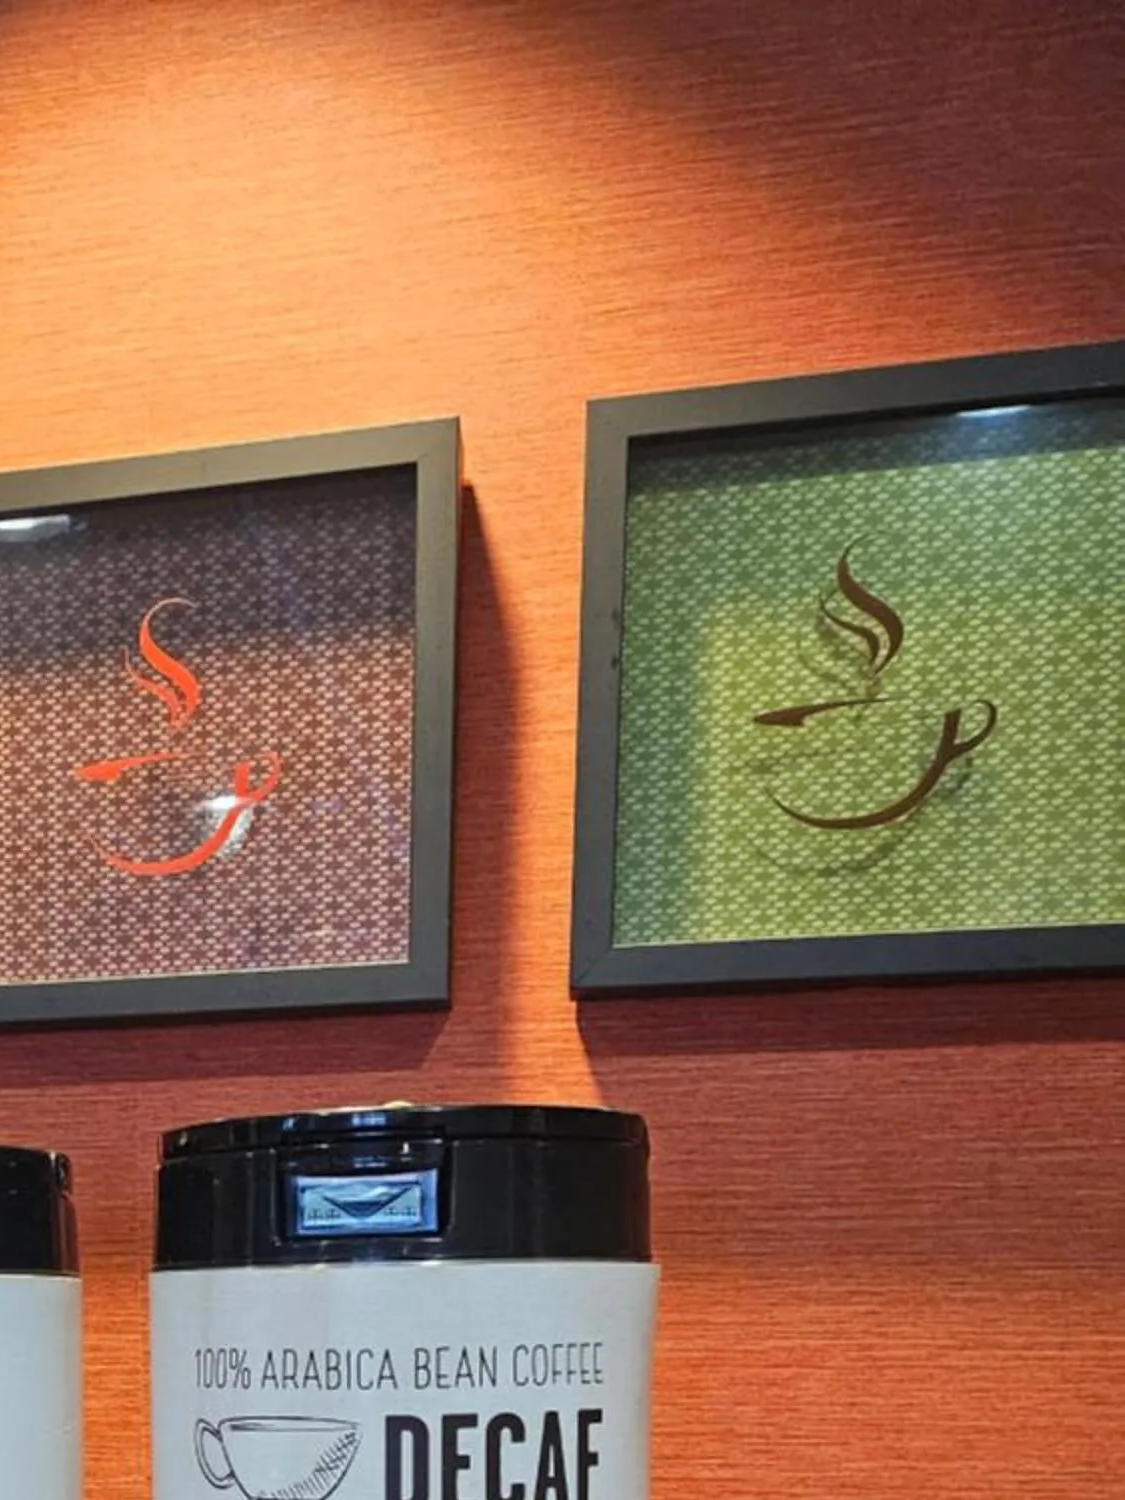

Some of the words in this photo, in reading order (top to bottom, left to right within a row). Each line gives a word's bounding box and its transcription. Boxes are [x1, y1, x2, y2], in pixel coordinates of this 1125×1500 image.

[194, 1348, 251, 1391] 100%
[261, 1347, 399, 1391] ARABICA
[414, 1345, 498, 1390] BEAN
[512, 1342, 604, 1387] COFFEE
